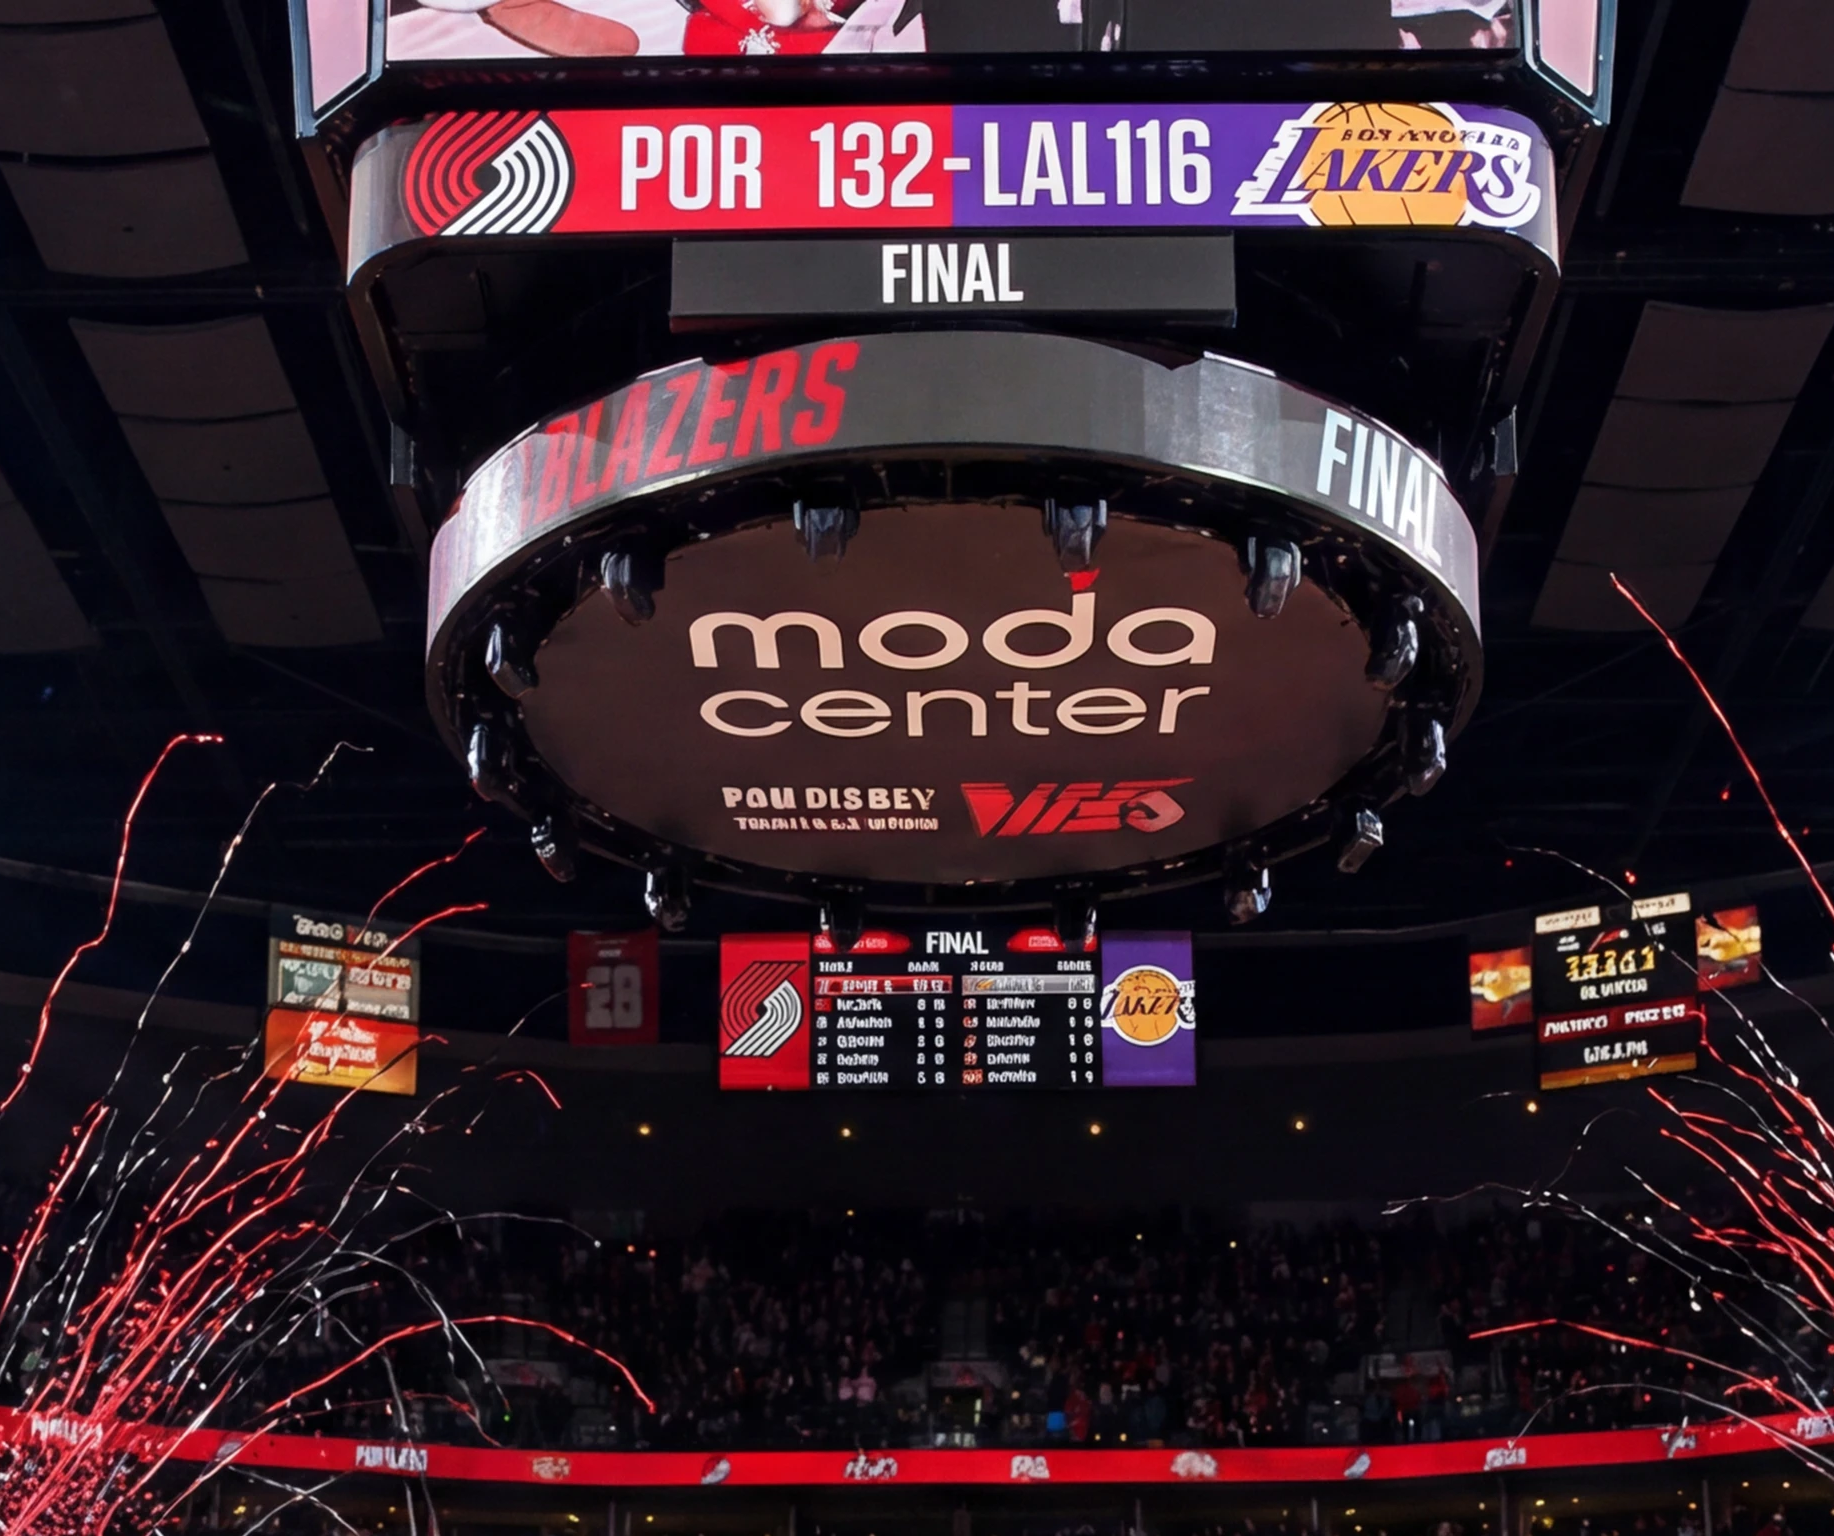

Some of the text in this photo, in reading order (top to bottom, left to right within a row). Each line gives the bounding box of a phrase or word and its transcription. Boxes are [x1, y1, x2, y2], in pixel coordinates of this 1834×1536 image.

[620, 124, 763, 211] POR
[882, 243, 1024, 304] FINAL
[1316, 407, 1443, 568] FINAL
[688, 591, 1218, 670] moda
[699, 681, 1212, 738] center
[925, 931, 990, 955] FINAL
